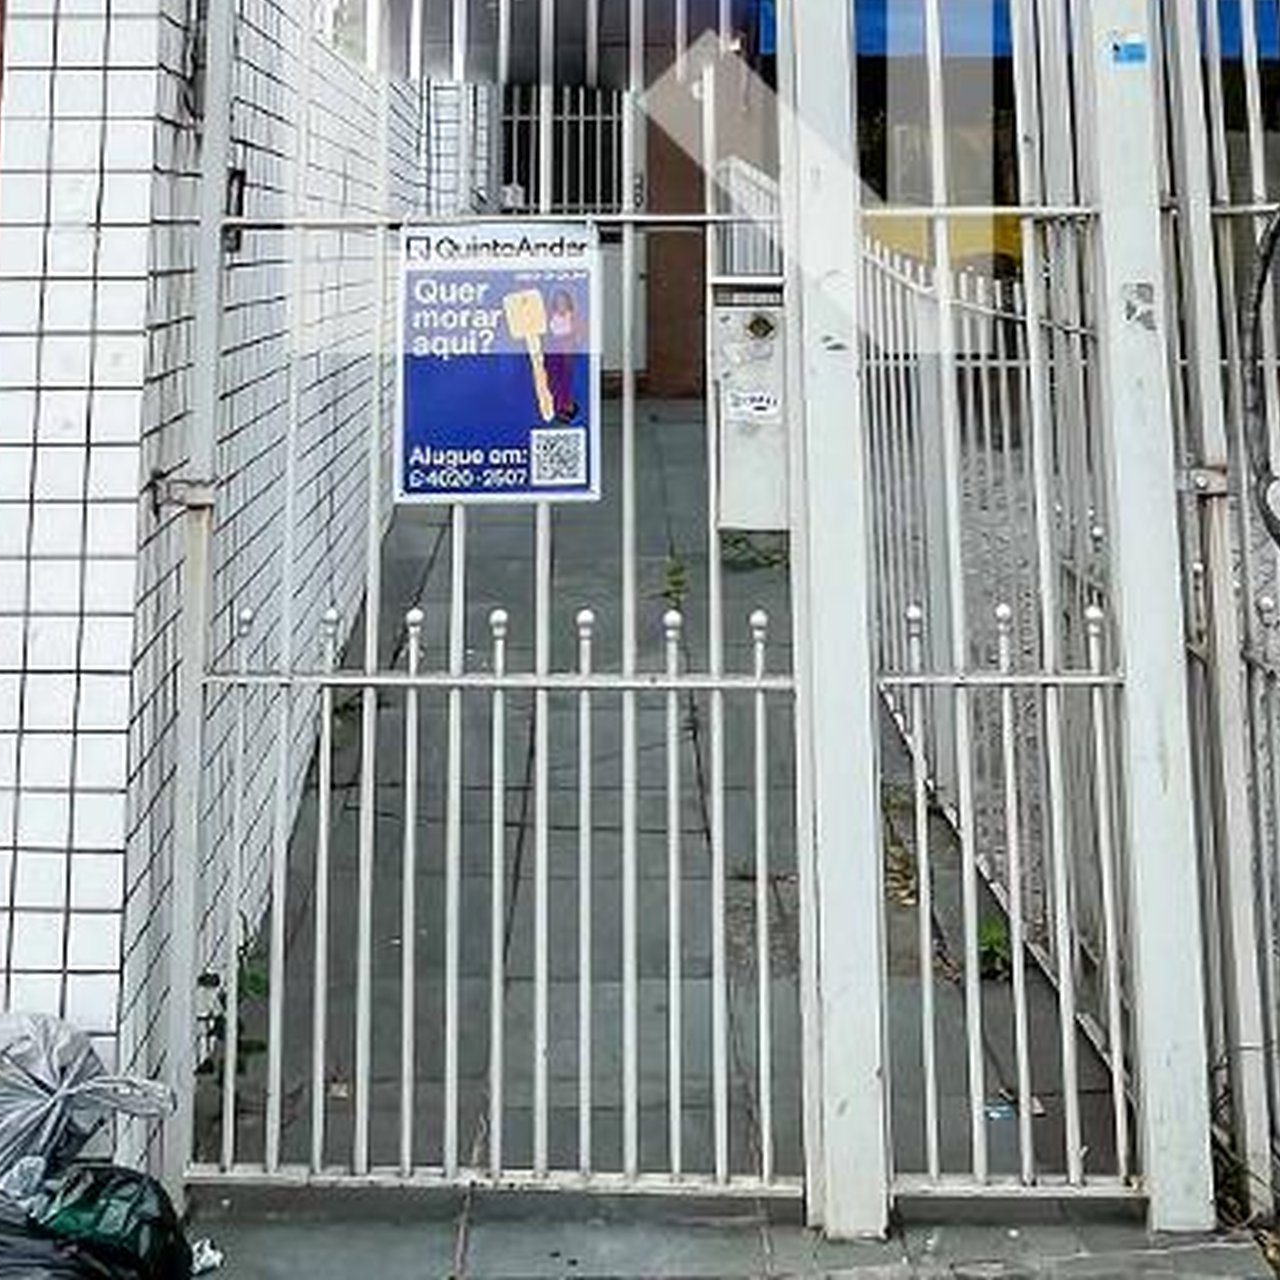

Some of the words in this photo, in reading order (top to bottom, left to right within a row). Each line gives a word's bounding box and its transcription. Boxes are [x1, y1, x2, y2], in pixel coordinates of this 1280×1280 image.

[436, 235, 588, 259] QuintoAndar
[414, 278, 490, 304] Quer
[412, 308, 503, 329] morar
[412, 329, 494, 360] aqui?
[489, 449, 528, 464] em:
